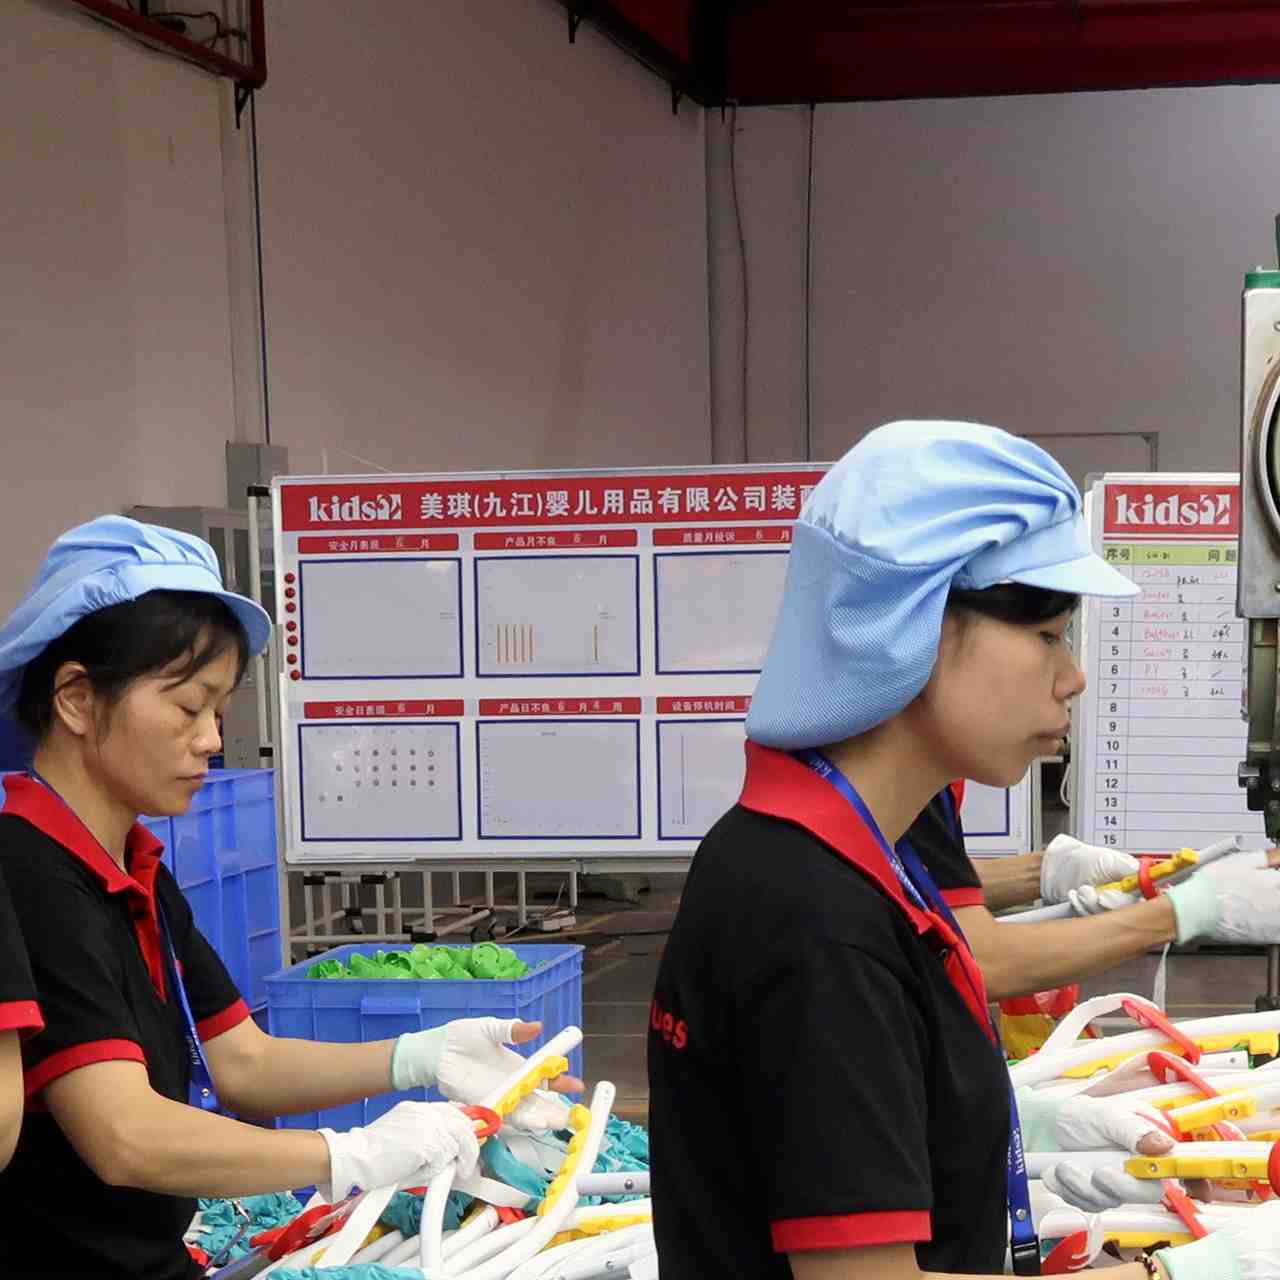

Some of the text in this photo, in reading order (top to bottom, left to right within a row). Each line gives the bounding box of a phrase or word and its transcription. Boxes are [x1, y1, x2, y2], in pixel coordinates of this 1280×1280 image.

[1106, 548, 1131, 561] 序号
[1112, 606, 1120, 617] 3
[1111, 626, 1119, 636] 4
[1111, 645, 1119, 656] 5
[1111, 664, 1119, 675] 6
[1111, 683, 1118, 694] 7
[1110, 702, 1117, 713] 8
[1109, 721, 1117, 732] 9
[1106, 740, 1120, 751] 10
[1105, 759, 1119, 770] 11
[1105, 778, 1119, 789] 12
[1104, 797, 1118, 808] 13
[1104, 816, 1118, 826] 14
[1103, 834, 1117, 845] 15
